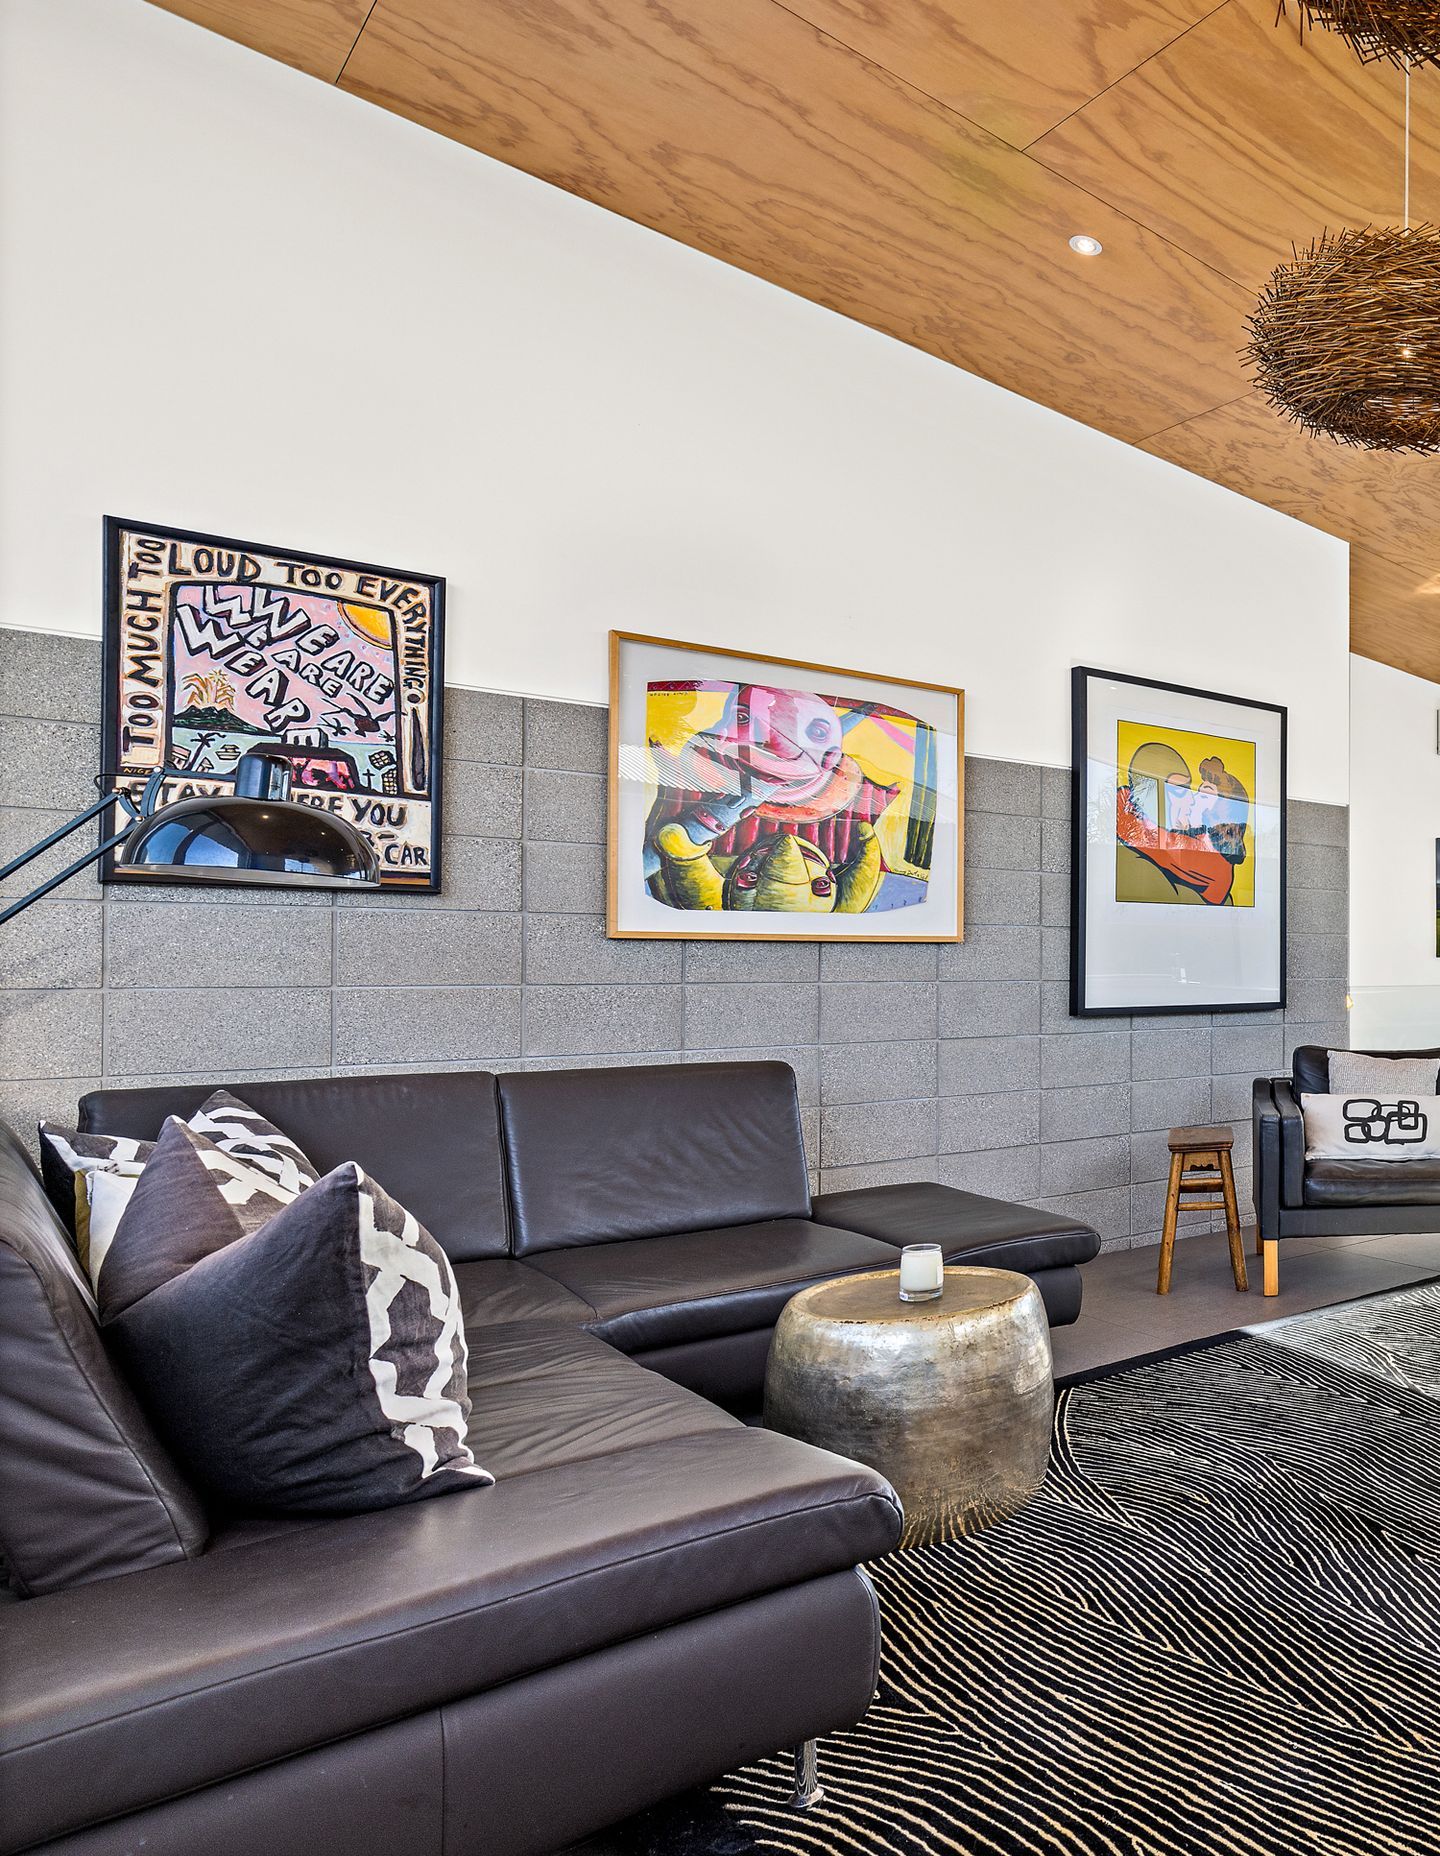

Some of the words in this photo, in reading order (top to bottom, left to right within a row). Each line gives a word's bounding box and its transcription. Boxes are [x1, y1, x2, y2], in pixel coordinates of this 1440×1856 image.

[128, 538, 166, 578] TOO
[168, 543, 262, 582] LOUD
[277, 561, 343, 590] TOO
[127, 590, 162, 687] MUCH
[271, 648, 343, 698] ARE
[320, 650, 396, 705] ARE
[122, 693, 160, 754] TOO
[350, 798, 408, 827] YOU
[384, 844, 429, 866] CAR
